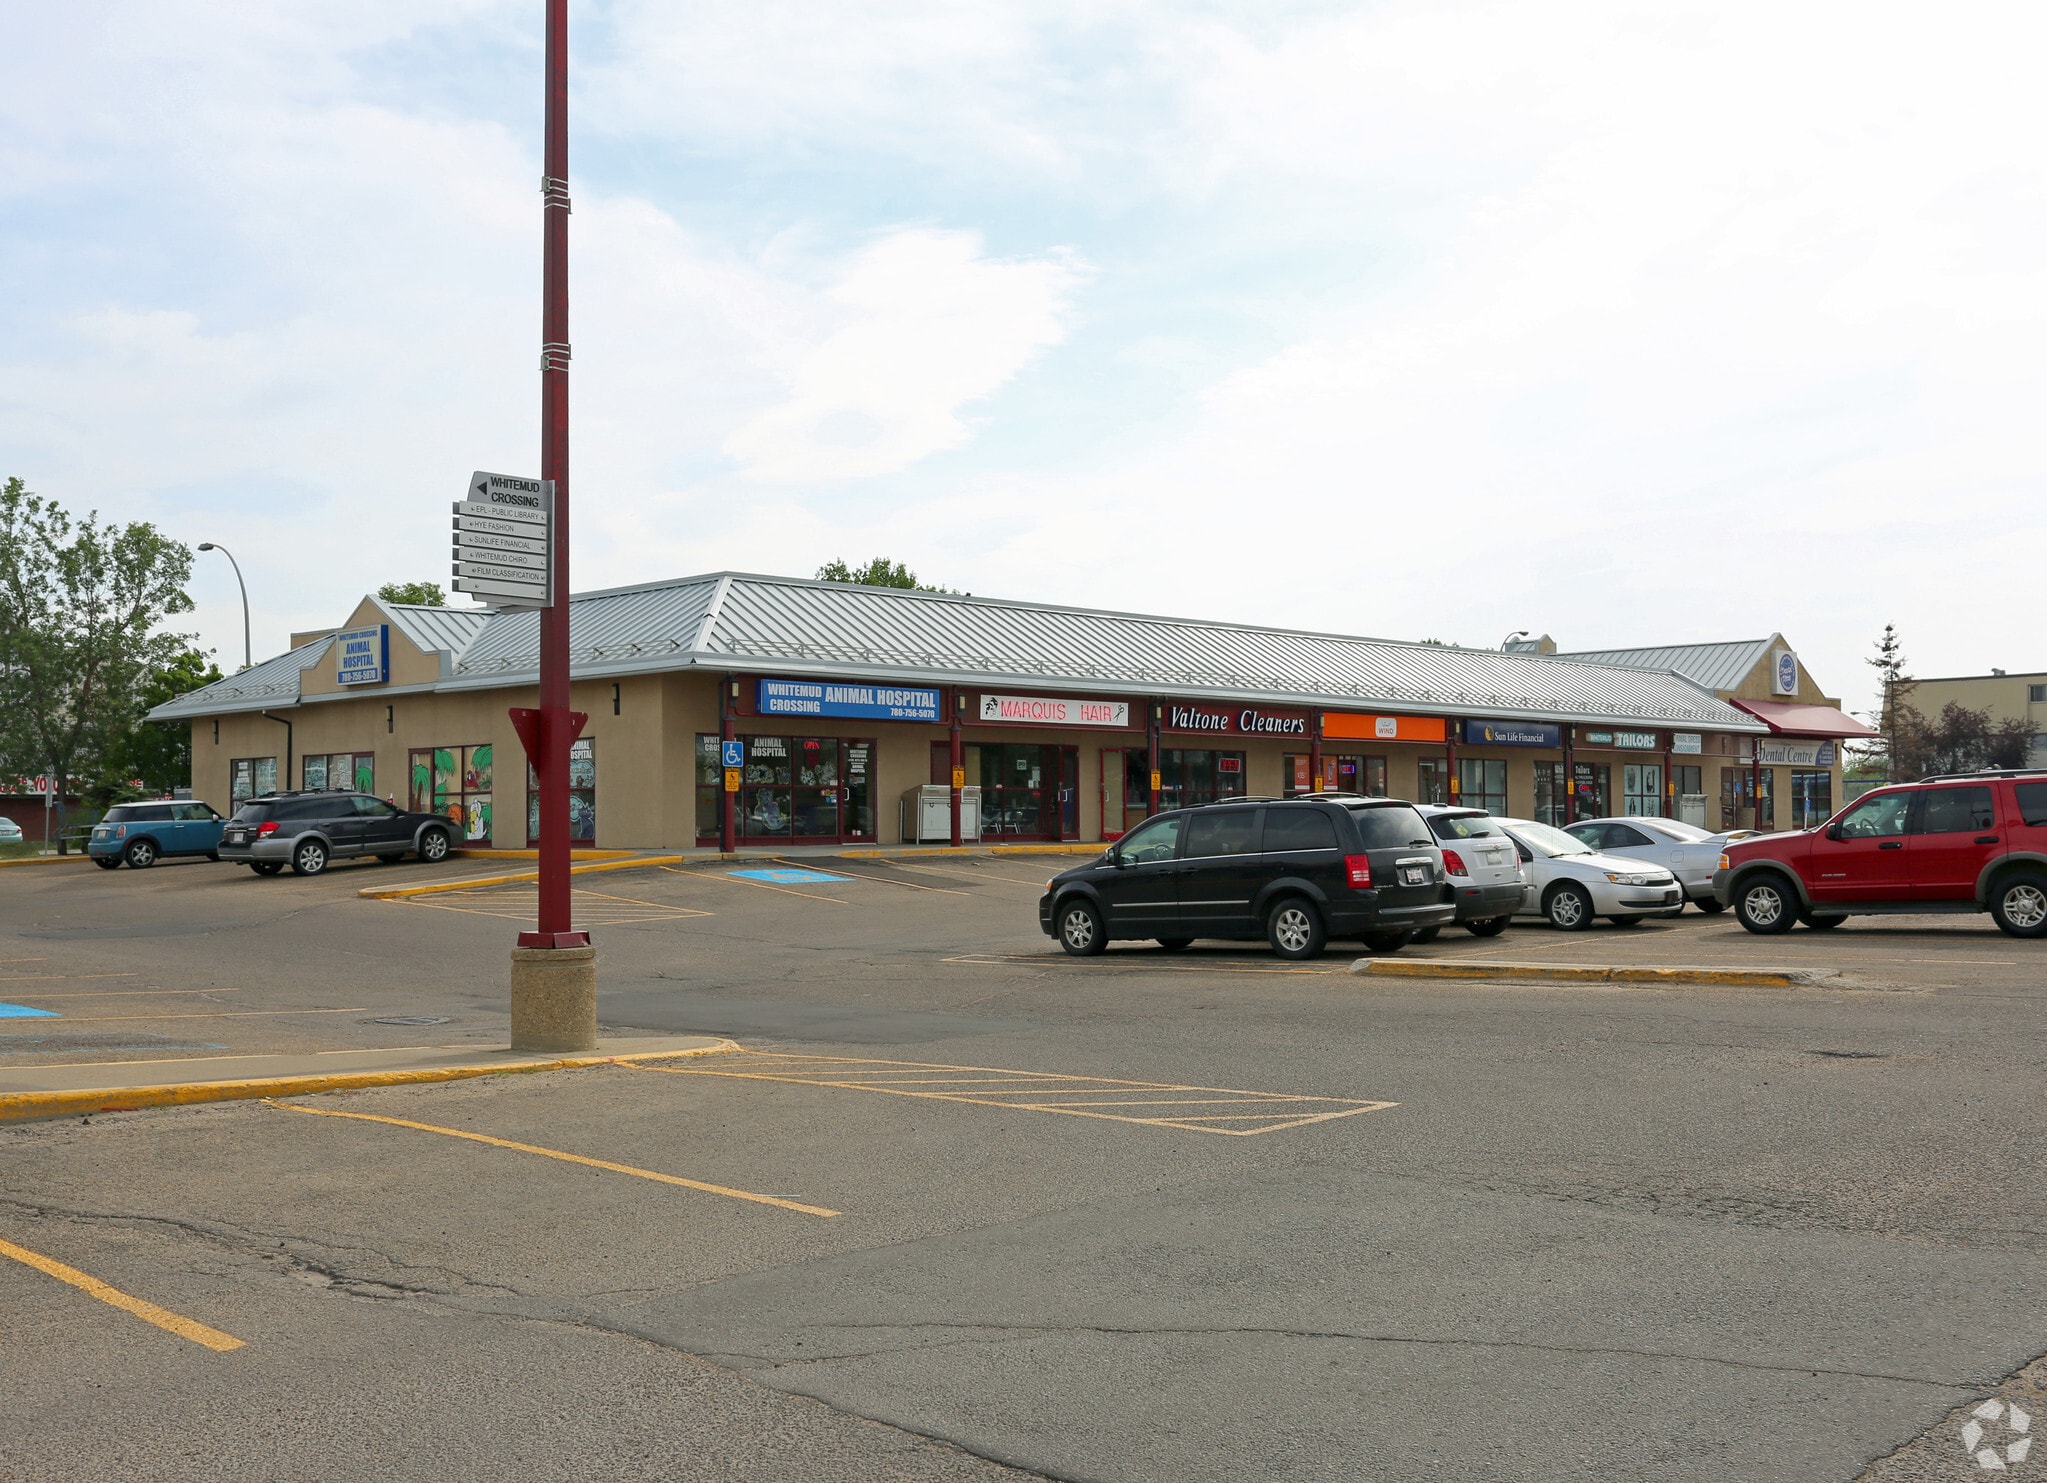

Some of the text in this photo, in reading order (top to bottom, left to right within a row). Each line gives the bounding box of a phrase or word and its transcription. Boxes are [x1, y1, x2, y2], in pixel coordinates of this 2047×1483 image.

[490, 477, 540, 492] WHITEMUD
[491, 492, 539, 508] CROSSING
[492, 508, 513, 516] PUBLIC
[514, 511, 538, 520] LIBRARY
[488, 522, 514, 532] FASHION
[474, 536, 530, 549] SUNLIFE FINANCIAL
[475, 552, 527, 564] WHITEMUD CHIRO
[492, 568, 539, 580] CLASSIFICATION
[346, 641, 370, 654] ANIMAL
[344, 654, 374, 668] HOSPITAL
[768, 683, 935, 708] WHITEMUD ANIMAL HOSPITAL
[770, 699, 934, 718] CROSSING 780-756-5070
[1001, 701, 1112, 721] MARQUIS HAIR
[1171, 706, 1305, 733] Valtone Cleaners
[754, 738, 783, 748] ANIMAL
[1495, 732, 1544, 742] Sun Life Financial
[1618, 733, 1655, 747] TAILORS
[804, 741, 820, 750] OPEN
[571, 750, 592, 759] OSPITAL
[752, 748, 786, 757] HOSPITAL
[1760, 747, 1785, 762] Dental
[1788, 747, 1812, 762] Centre
